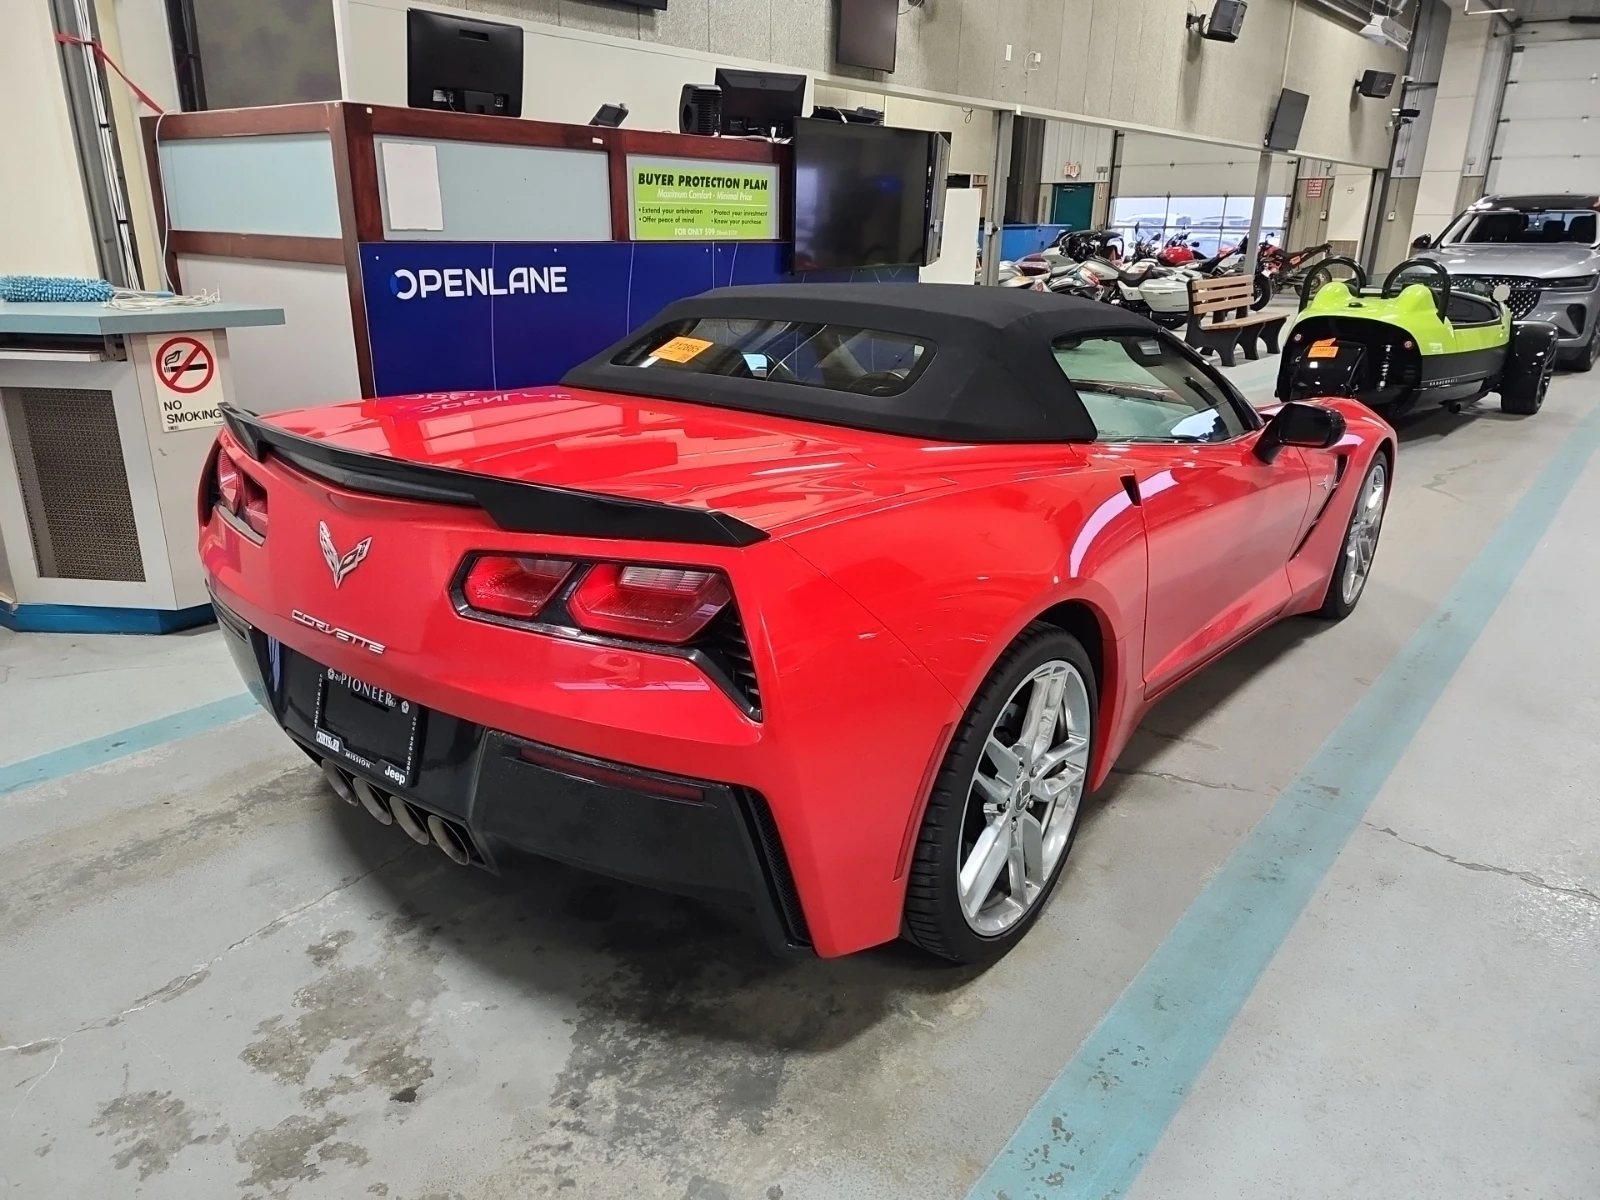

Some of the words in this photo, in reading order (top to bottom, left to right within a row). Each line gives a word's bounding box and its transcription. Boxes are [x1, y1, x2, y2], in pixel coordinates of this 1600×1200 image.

[638, 172, 674, 186] BUYER
[678, 175, 740, 189] PROTECTION
[743, 179, 768, 190] PLAN
[657, 188, 688, 199] Maximum
[689, 190, 712, 199] Comfort
[716, 191, 739, 200] Minimal
[739, 192, 752, 201] Price
[641, 206, 661, 214] Extend
[676, 207, 703, 215] arbitration
[658, 217, 674, 225] peace
[741, 218, 762, 226] purchase
[674, 227, 687, 236] FOR
[687, 228, 704, 236] ONLY
[704, 227, 716, 236] $99
[390, 266, 568, 300] OPENLANE
[163, 400, 182, 411] NO
[166, 408, 222, 424] SMOKING
[291, 609, 386, 654] CORVETTE
[340, 673, 392, 705] PIONEER
[345, 751, 371, 768] MISSION
[384, 765, 406, 785] Jeep
